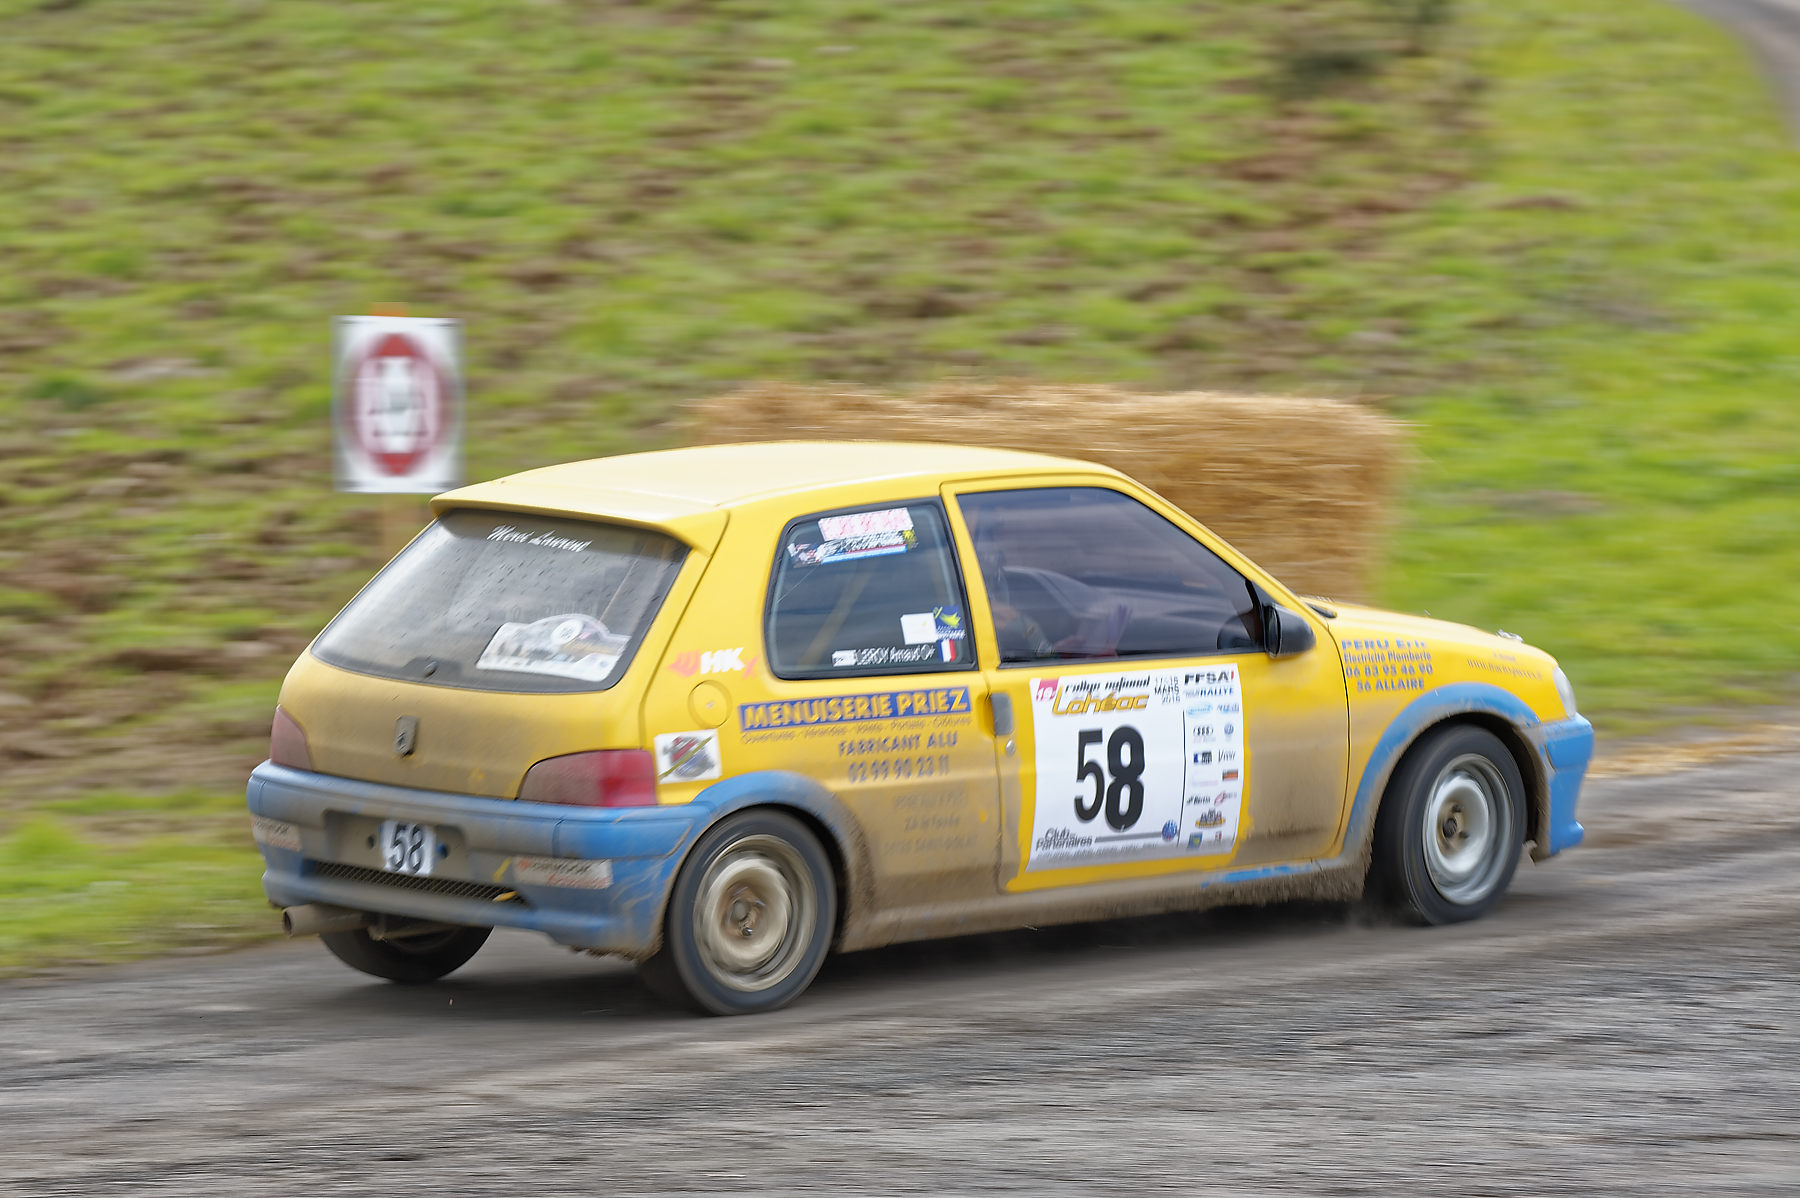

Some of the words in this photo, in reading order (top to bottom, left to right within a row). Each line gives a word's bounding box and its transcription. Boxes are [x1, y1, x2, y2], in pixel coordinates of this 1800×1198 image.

[1184, 671, 1230, 685] FFSA
[1345, 666, 1361, 678] 06
[1065, 680, 1101, 694] rallye
[1105, 675, 1151, 692] national
[1375, 677, 1425, 692] ALLAIRE
[744, 694, 892, 729] MENUISERIE
[896, 688, 968, 716] PRIEZ
[1052, 685, 1150, 715] Lohéac
[838, 735, 920, 756] FABRICANT
[927, 732, 958, 749] ALU
[847, 761, 868, 784] 02
[871, 759, 891, 782] 99
[939, 754, 950, 776] 11
[1074, 726, 1146, 832] 58
[1044, 826, 1071, 840] Club
[389, 823, 426, 874] 58
